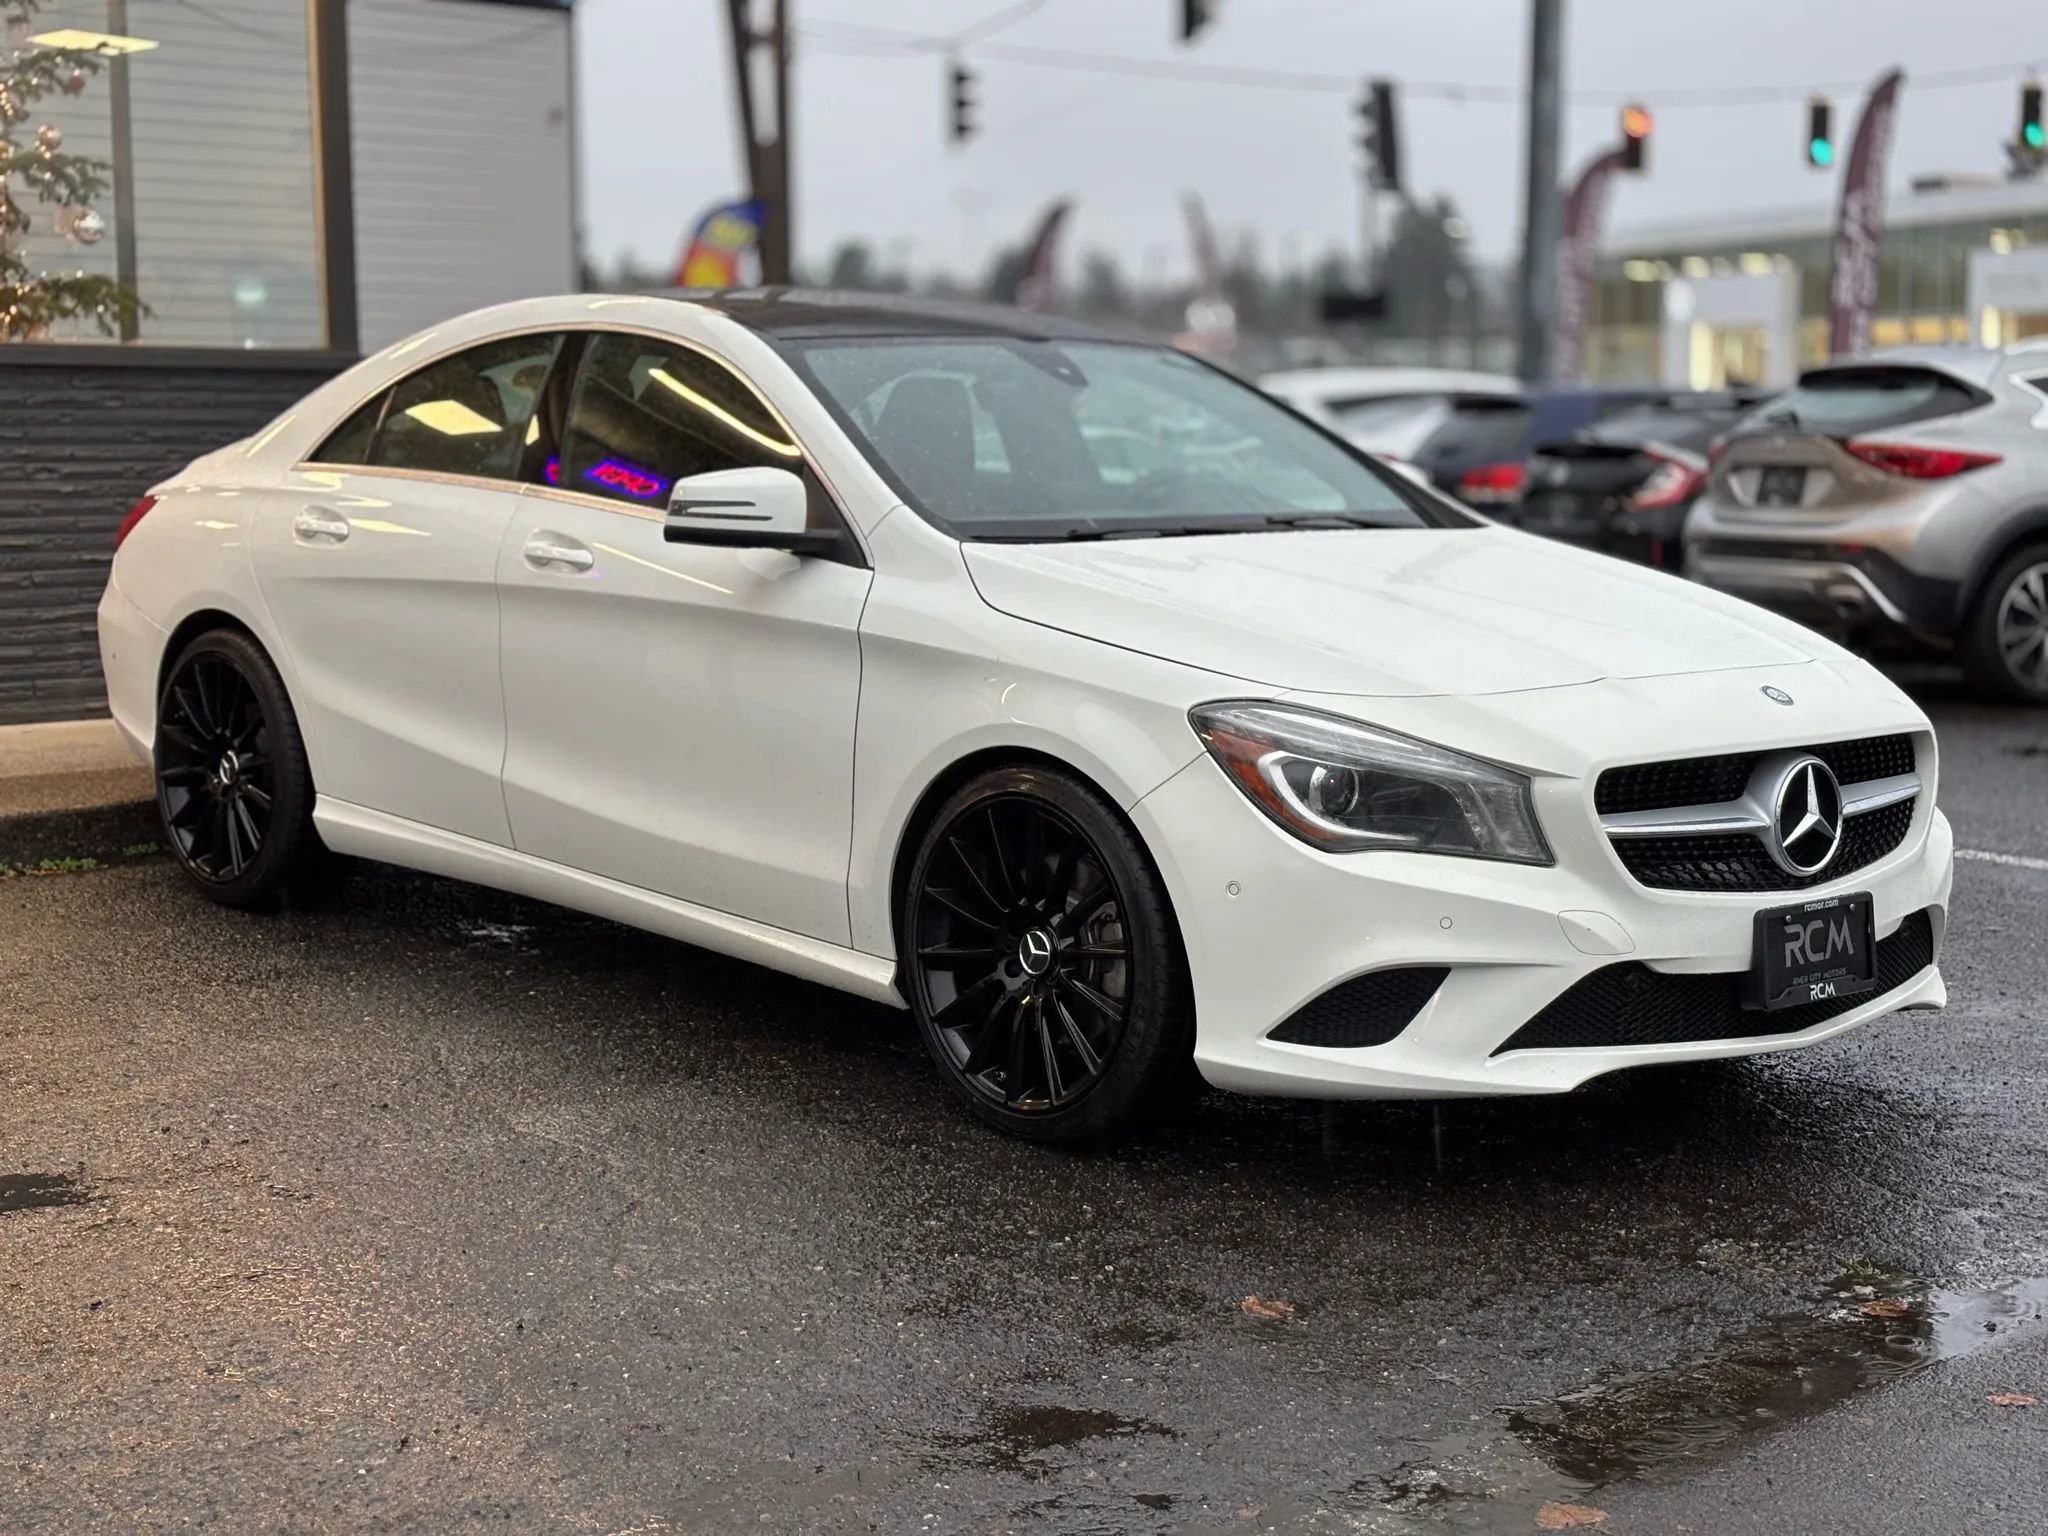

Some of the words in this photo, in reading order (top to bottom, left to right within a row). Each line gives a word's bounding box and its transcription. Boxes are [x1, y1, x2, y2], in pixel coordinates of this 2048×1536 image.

[1784, 915, 1854, 968] RCM
[1809, 972, 1822, 981] CITY
[1809, 982, 1835, 1000] RCM
